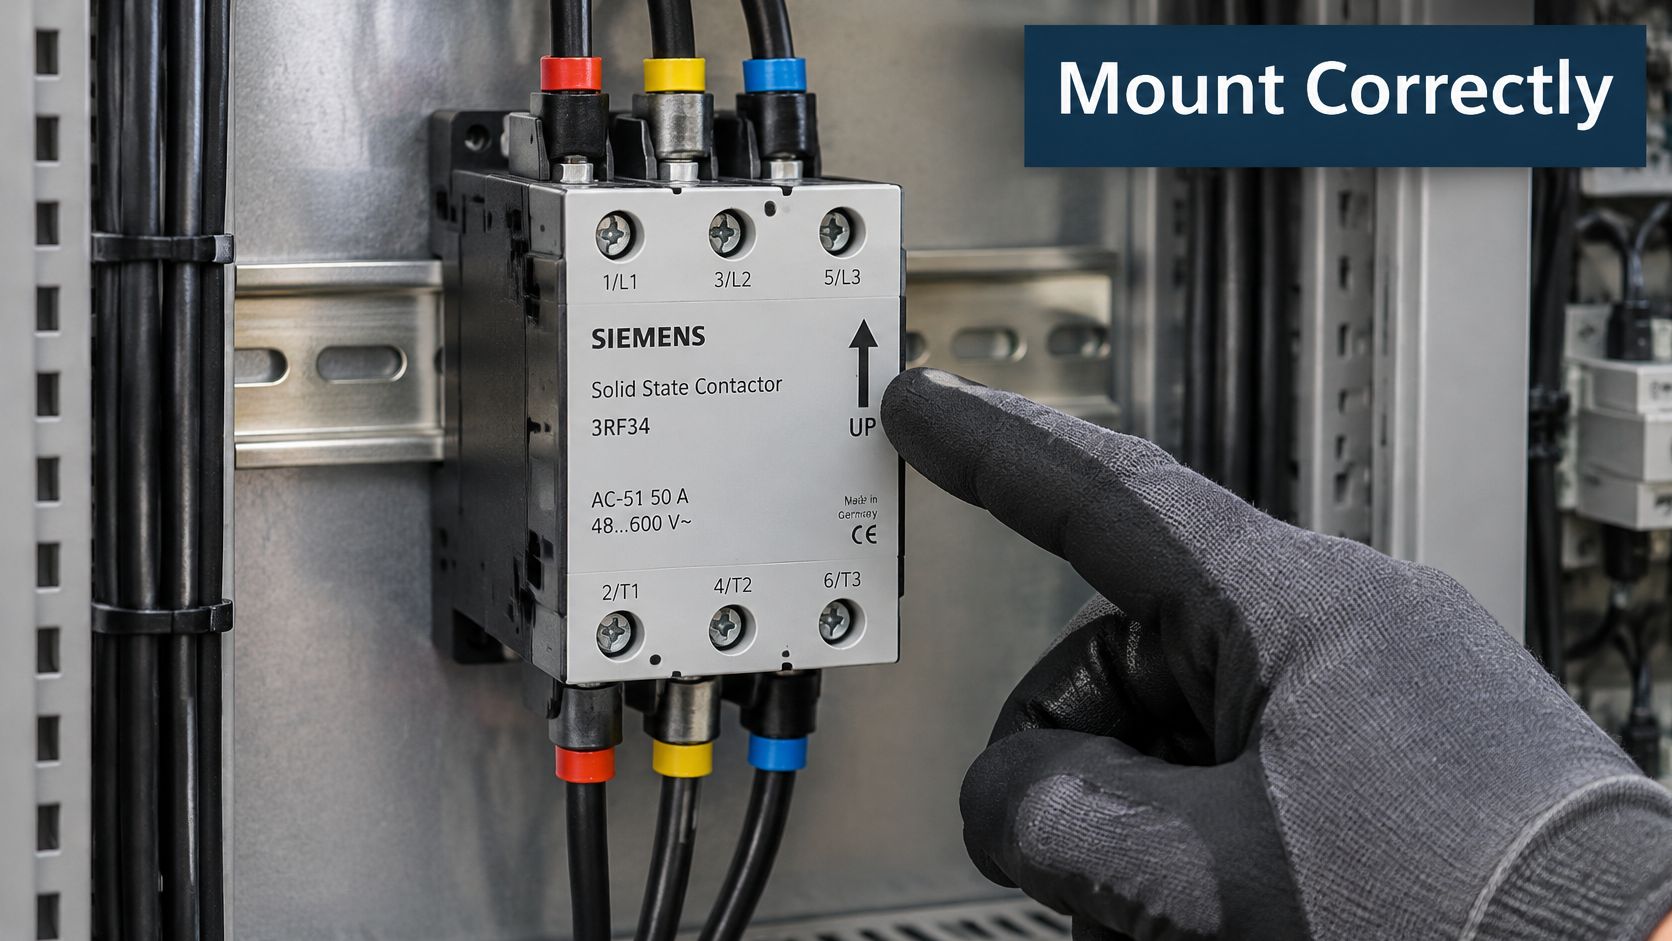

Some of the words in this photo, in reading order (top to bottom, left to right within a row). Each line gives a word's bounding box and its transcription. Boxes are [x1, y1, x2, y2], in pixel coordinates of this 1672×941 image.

[604, 274, 636, 291] 1/L1
[715, 271, 751, 288] 3/L2
[825, 269, 860, 286] 5/L3
[592, 326, 705, 349] SIEMENS
[592, 380, 635, 398] Solid
[643, 380, 688, 397] State
[696, 377, 782, 394] Contactor
[592, 418, 650, 436] 3RF34
[850, 418, 876, 437] UP
[592, 490, 642, 508] AC-51
[652, 489, 671, 505] 50
[677, 488, 688, 504] A
[870, 494, 878, 504] in
[592, 515, 662, 533] 48...600
[851, 524, 877, 545] CE
[714, 577, 751, 594] 4/T2
[824, 572, 860, 588] 6/T3
[603, 584, 637, 601] 2/T1
